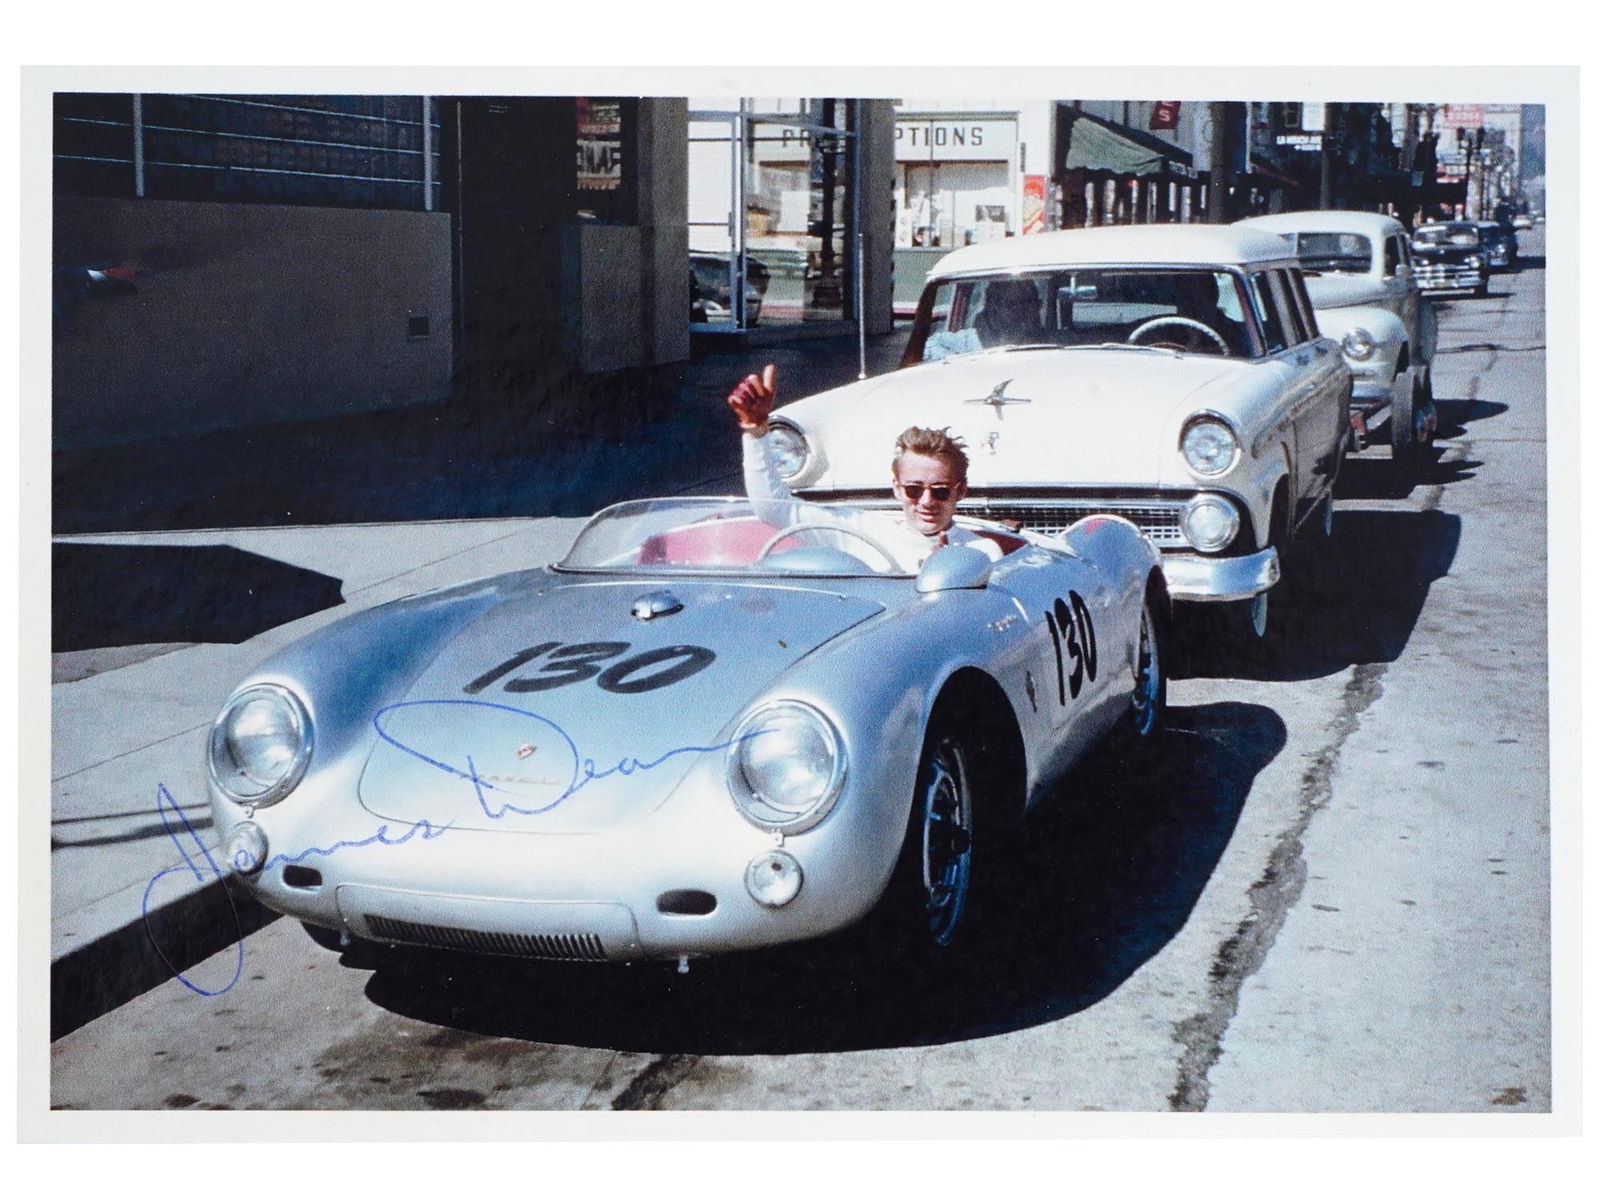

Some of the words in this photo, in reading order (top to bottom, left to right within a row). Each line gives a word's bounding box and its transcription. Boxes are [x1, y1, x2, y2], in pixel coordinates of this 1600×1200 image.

[463, 641, 716, 694] 130
[1044, 589, 1097, 706] 130
[374, 699, 778, 819] Dean
